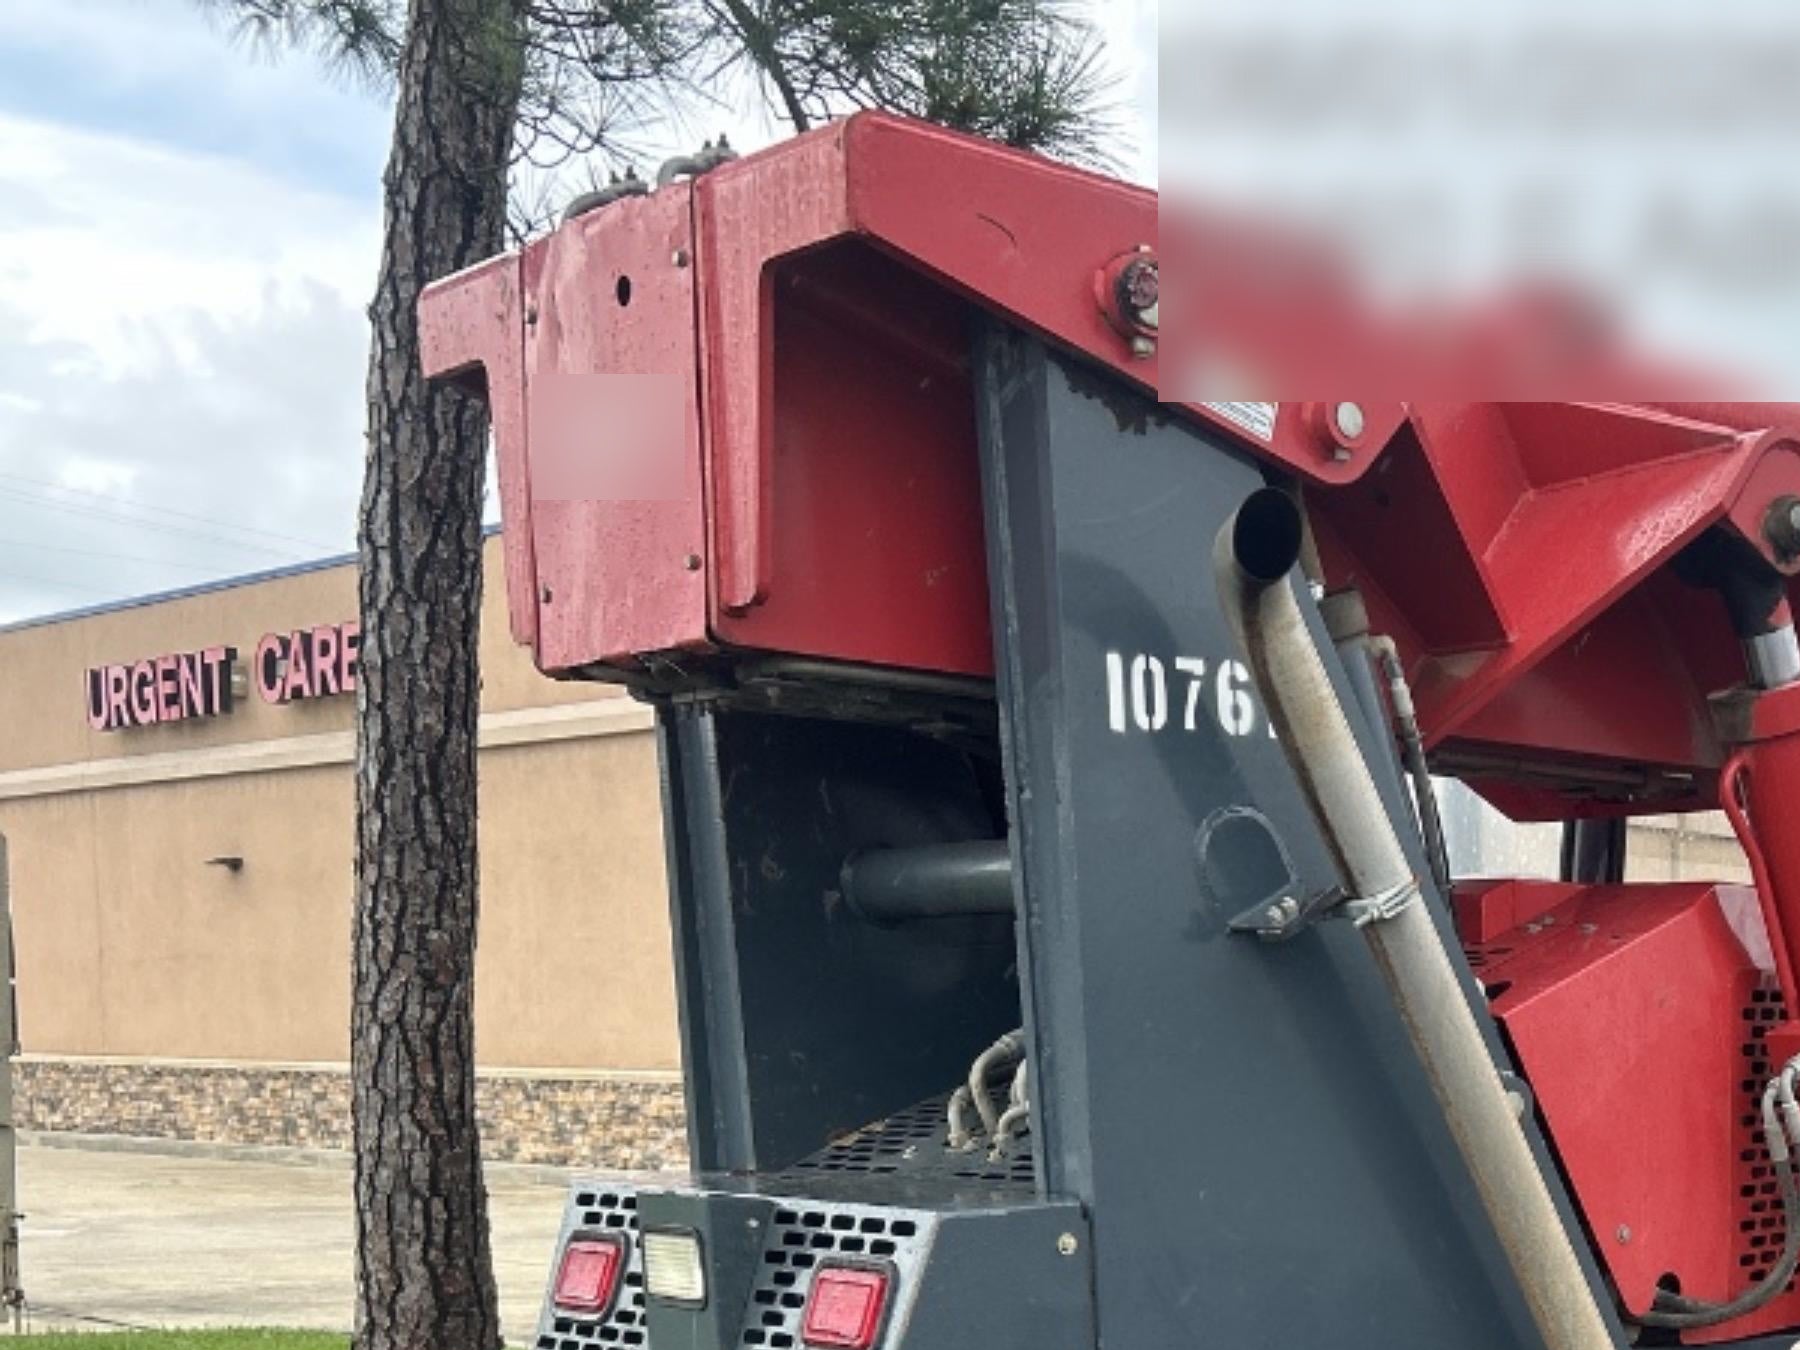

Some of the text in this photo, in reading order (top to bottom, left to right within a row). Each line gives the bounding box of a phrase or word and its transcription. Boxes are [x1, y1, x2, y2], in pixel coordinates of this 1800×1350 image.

[85, 621, 360, 731] URGENT CARE
[1106, 651, 1278, 740] 1076
